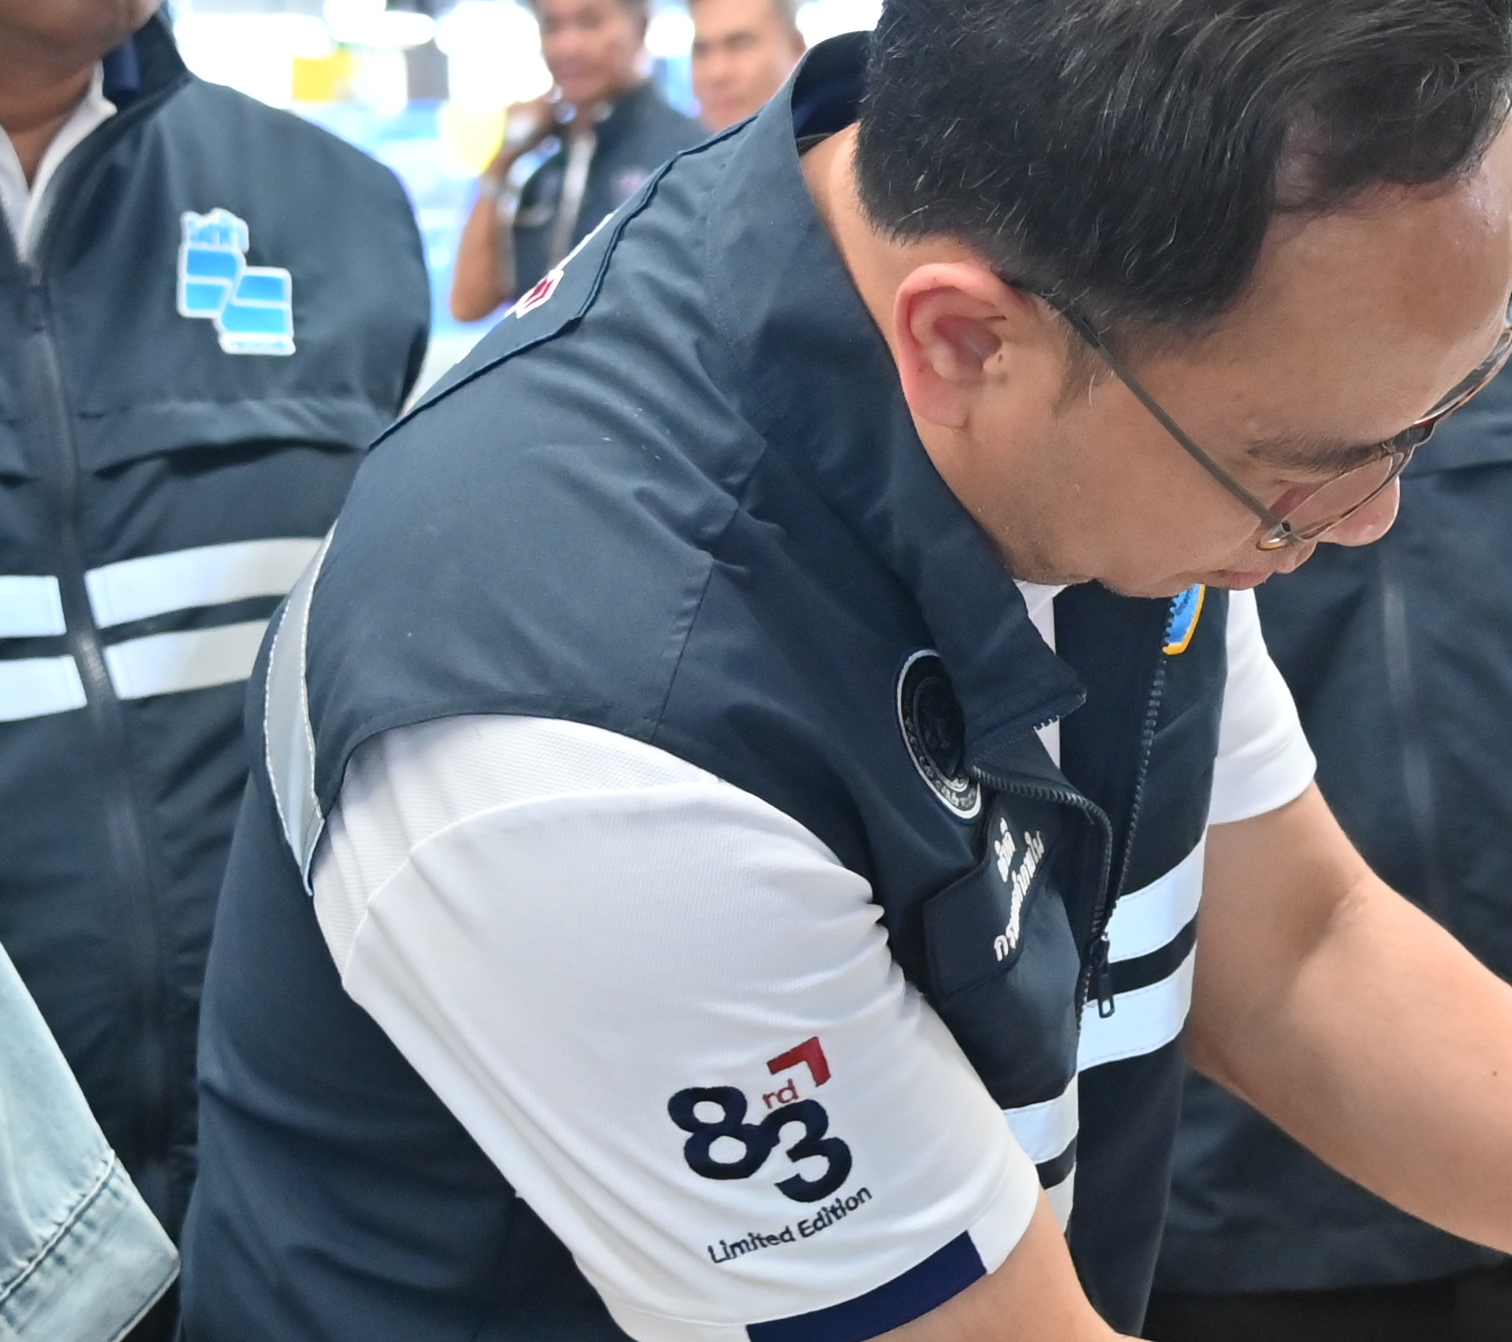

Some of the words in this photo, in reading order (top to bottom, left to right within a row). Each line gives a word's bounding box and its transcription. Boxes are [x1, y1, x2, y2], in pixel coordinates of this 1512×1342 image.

[668, 1085, 853, 1203] 83
[762, 1079, 799, 1111] rd
[707, 1222, 795, 1265] Limited
[797, 1185, 873, 1239] Edition
